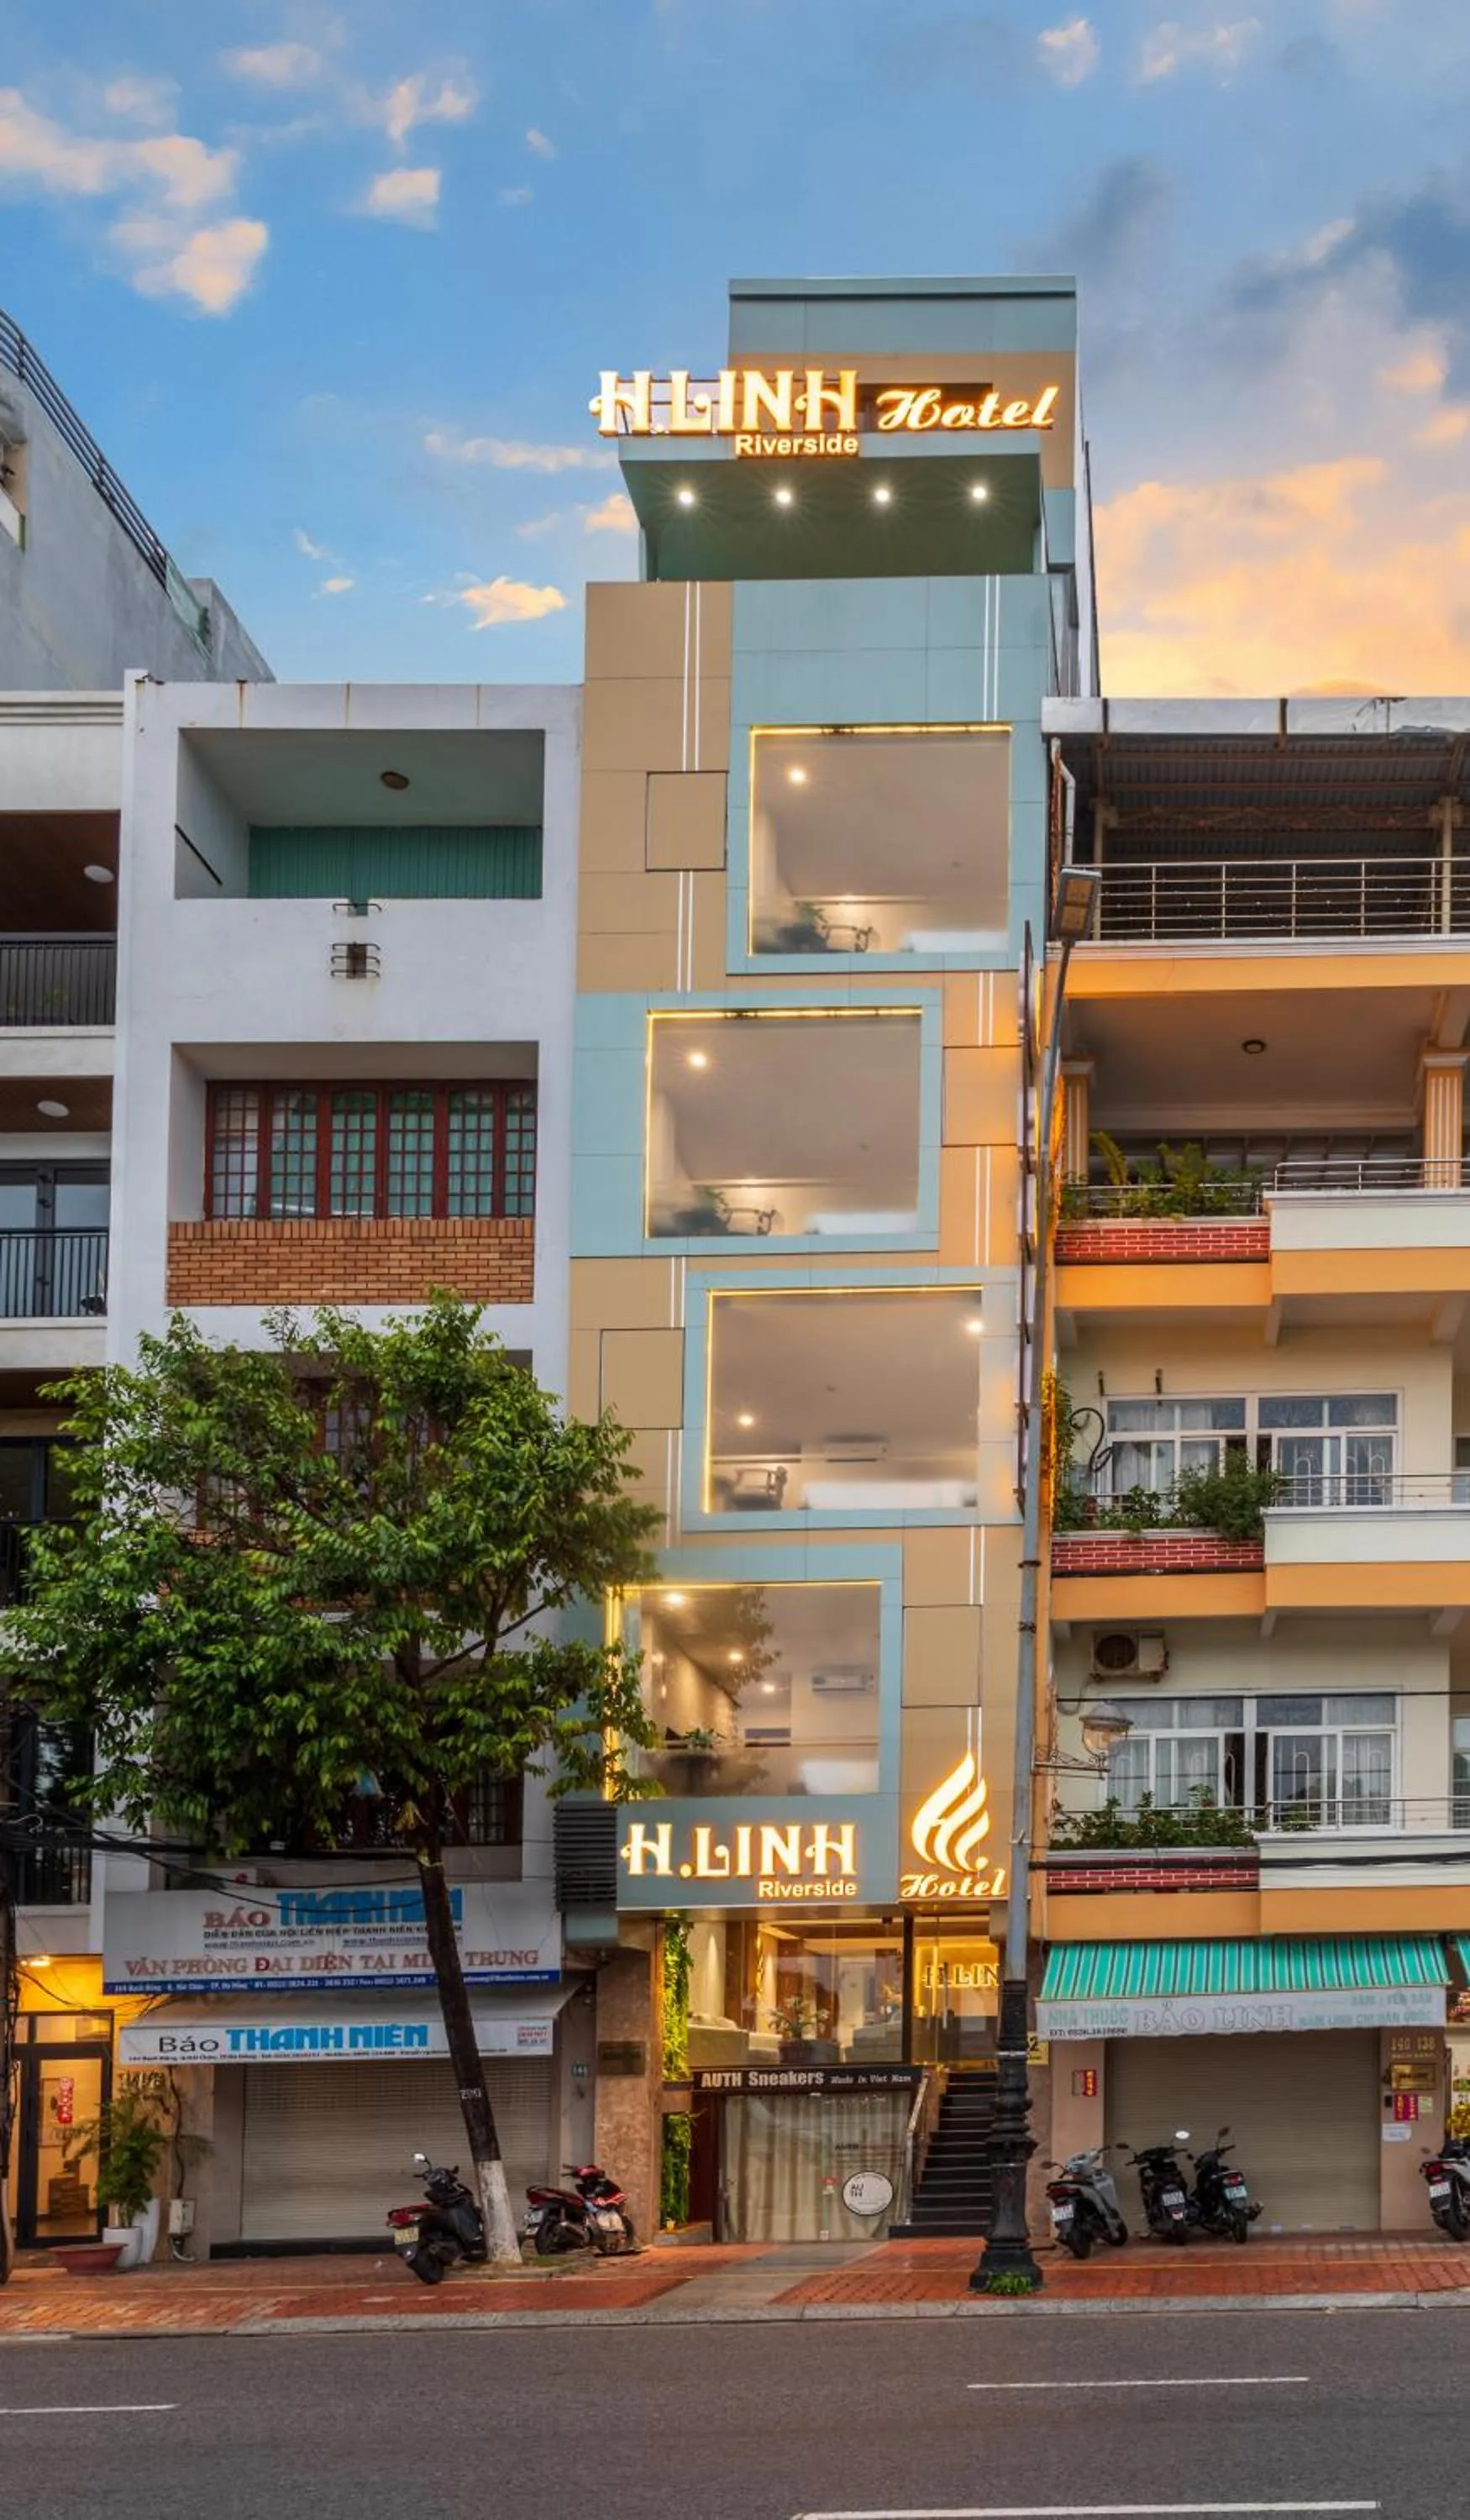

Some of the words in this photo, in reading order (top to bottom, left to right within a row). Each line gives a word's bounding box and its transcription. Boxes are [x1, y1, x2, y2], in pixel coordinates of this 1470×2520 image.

[875, 385, 1060, 431] Hotel
[735, 433, 859, 455] Riverside
[620, 1823, 857, 1878] H.LINH
[900, 1868, 1007, 1898] Hotel
[759, 1880, 858, 1898] Riverside
[203, 1905, 270, 1928] BÁO
[124, 1956, 167, 1977] VĂN
[172, 1954, 248, 1975] PHÒNG
[255, 1956, 294, 1976] ĐẠI
[299, 1950, 354, 1974] DIỆN
[360, 1953, 396, 1973] TẠI
[464, 1950, 539, 1966] TRUNG
[1210, 2003, 1293, 2031] LINH
[159, 2035, 219, 2053] Báo
[225, 2026, 344, 2050] THANH
[349, 2023, 428, 2049] NIÊN
[701, 2072, 742, 2088] AUTH
[748, 2071, 825, 2087] Sneakers
